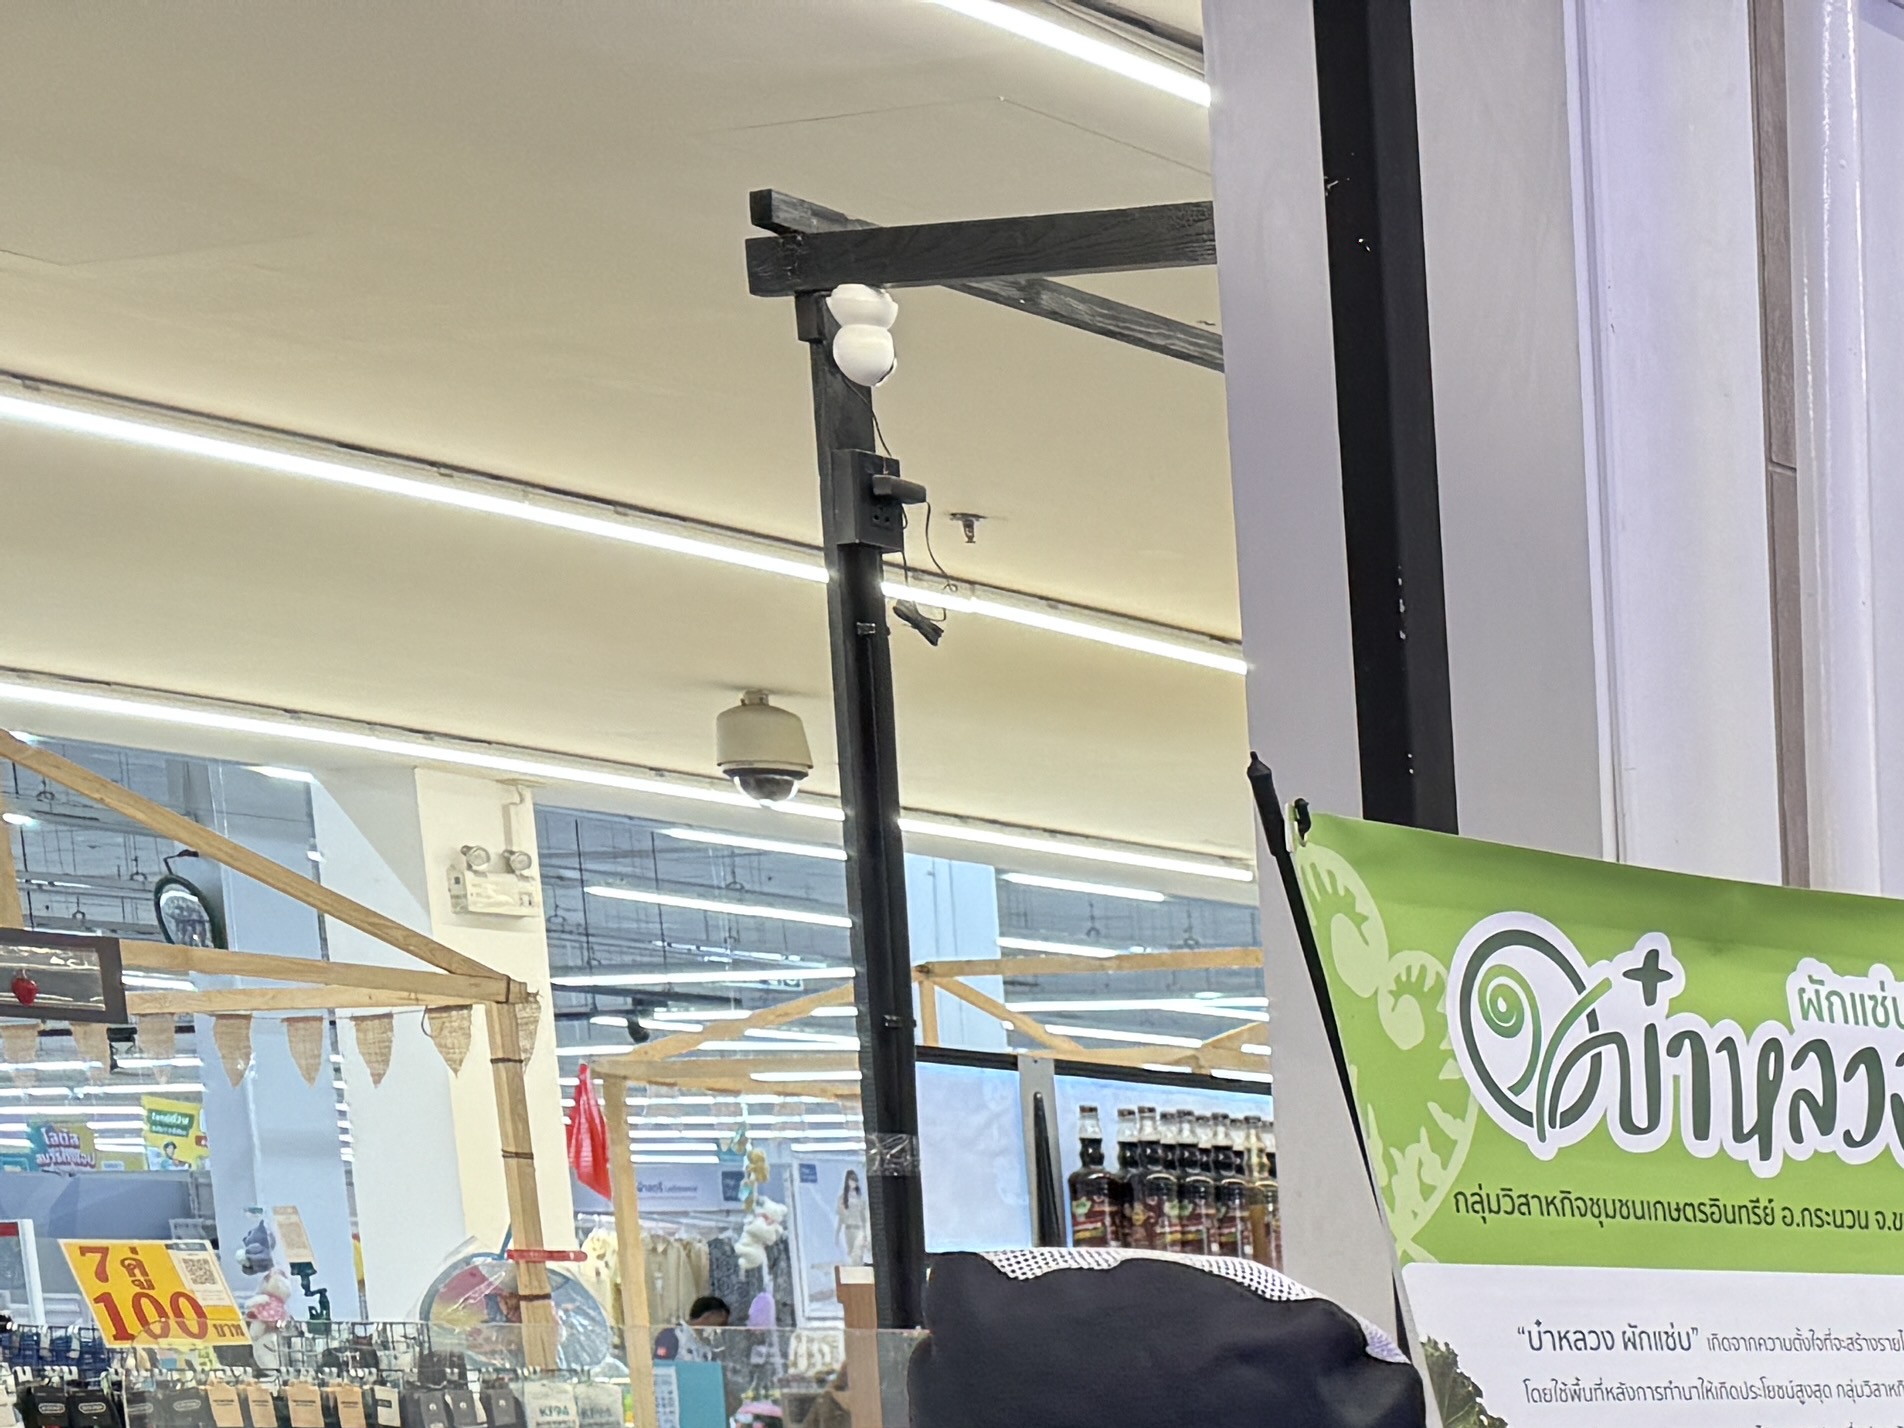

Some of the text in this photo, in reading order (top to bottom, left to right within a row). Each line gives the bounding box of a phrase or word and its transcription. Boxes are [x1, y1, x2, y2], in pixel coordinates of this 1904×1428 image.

[1454, 1183, 1775, 1229] กลุ่มวิสาหกิจชุมชนเกษตรอินทรีย์
[1781, 1203, 1869, 1230] อ.กระนวน
[79, 1246, 156, 1291] 7 คู่
[93, 1291, 209, 1341] 100
